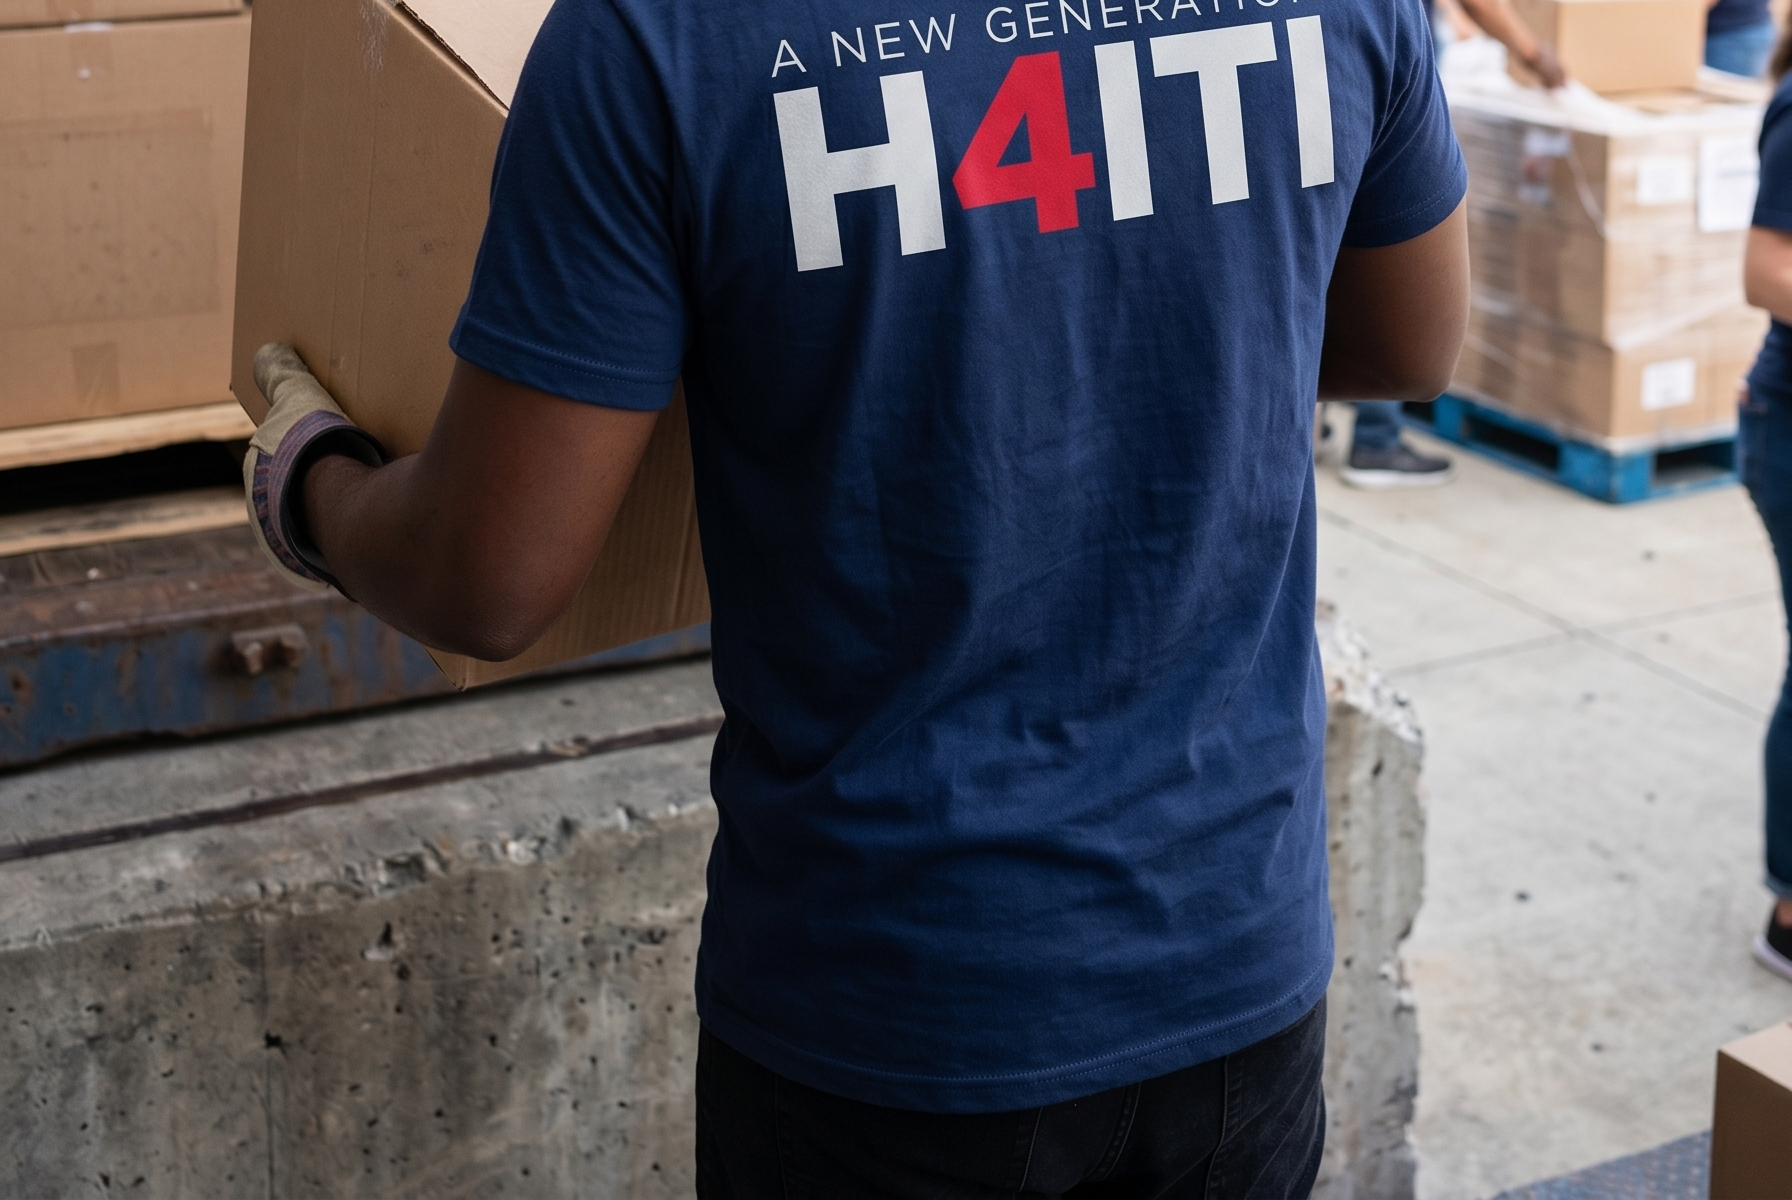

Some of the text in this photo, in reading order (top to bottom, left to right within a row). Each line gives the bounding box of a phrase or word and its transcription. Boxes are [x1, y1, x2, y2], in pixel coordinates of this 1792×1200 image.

[771, 39, 807, 78] A
[831, 13, 957, 67] NEW
[773, 15, 1335, 272] H4ITI
